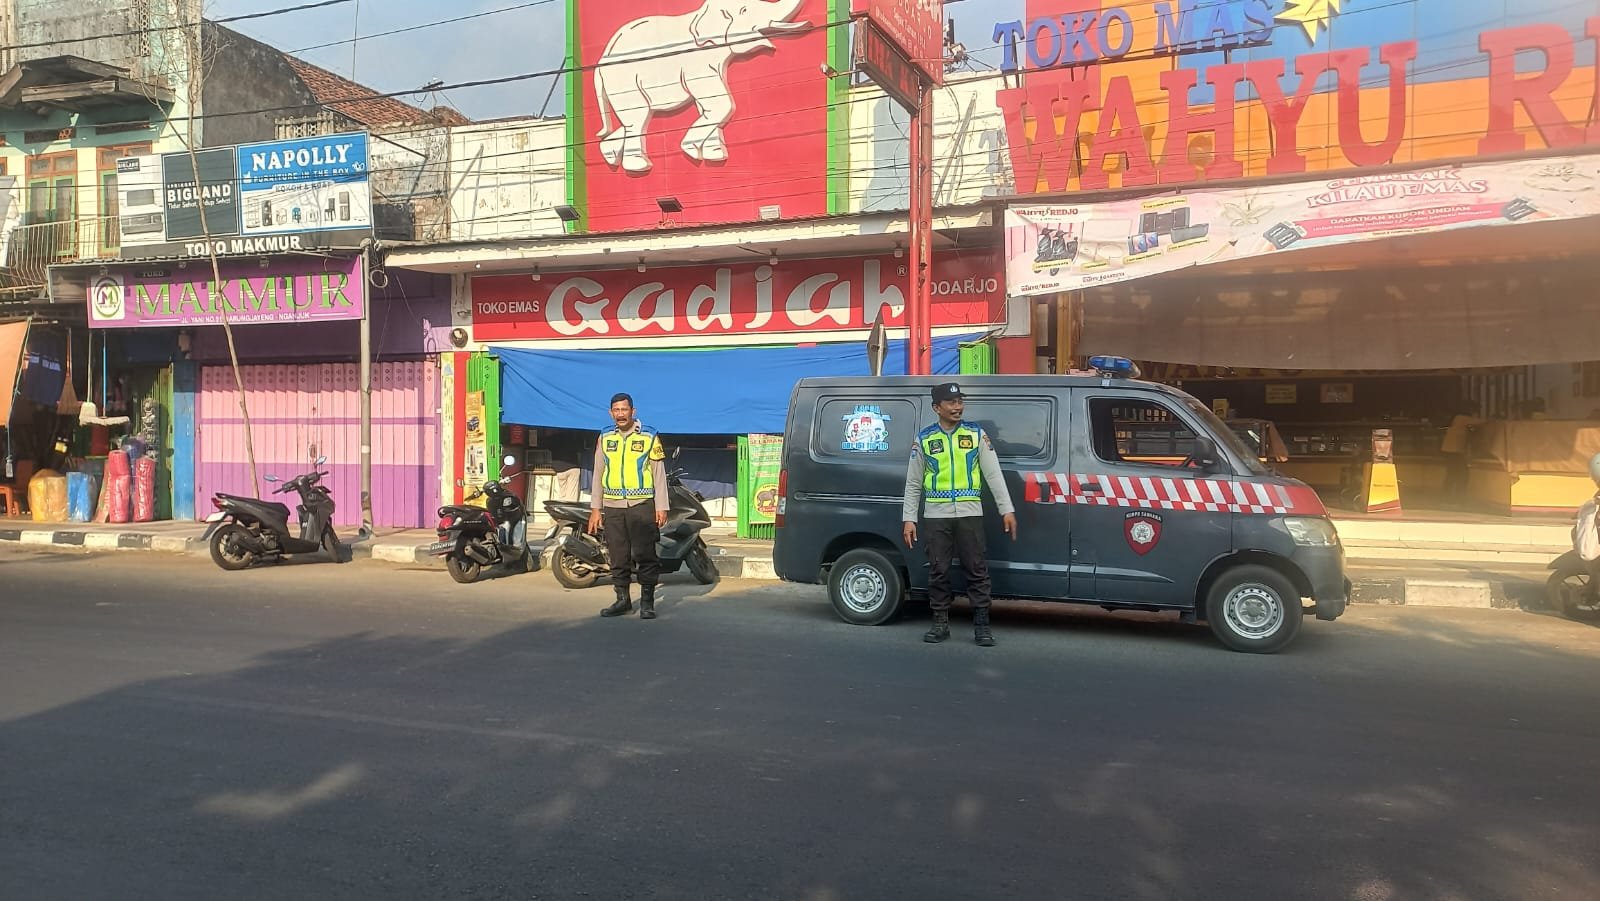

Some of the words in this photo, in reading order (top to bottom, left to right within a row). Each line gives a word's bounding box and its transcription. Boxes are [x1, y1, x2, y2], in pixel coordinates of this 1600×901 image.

[992, 7, 1134, 73] TOKO
[1153, 0, 1273, 50] MAS
[996, 41, 1417, 194] WAHYU
[1478, 17, 1600, 155] R
[252, 144, 350, 171] NAPOLLY
[254, 172, 298, 183] FURNITURE
[333, 167, 349, 176] BOX
[167, 184, 231, 202] BIGLAND
[1306, 182, 1396, 208] KILAU
[1403, 179, 1489, 197] EMAS
[1330, 214, 1385, 224] DAPATKAN
[184, 241, 227, 257] TOKO
[230, 236, 301, 252] MAKMUR
[135, 272, 353, 317] MAKMUR
[477, 302, 507, 314] TOKO
[508, 300, 540, 313] EMAS
[545, 259, 905, 336] Gadjah
